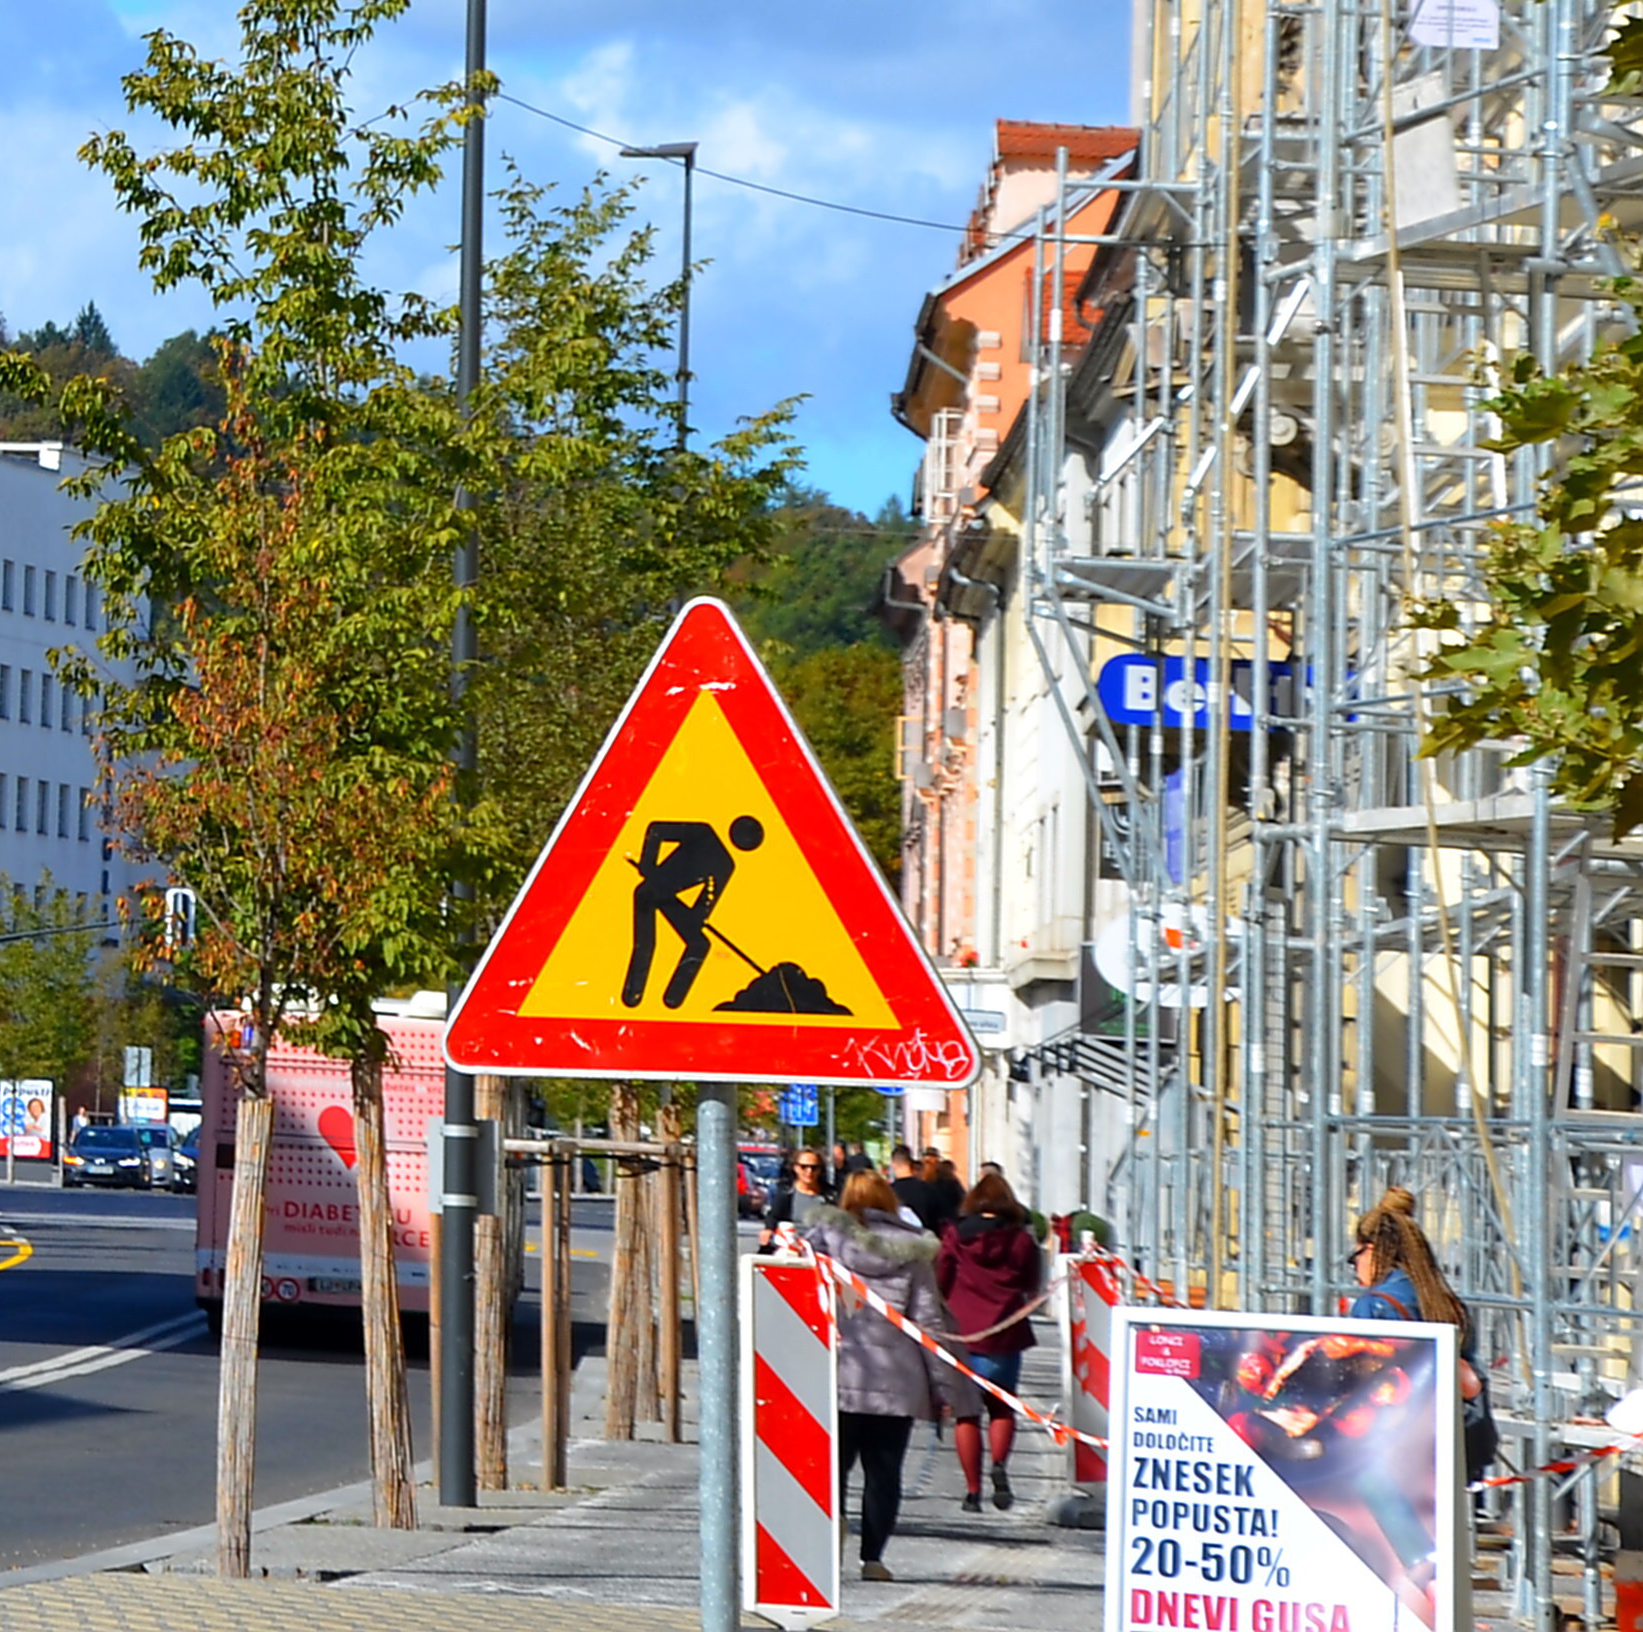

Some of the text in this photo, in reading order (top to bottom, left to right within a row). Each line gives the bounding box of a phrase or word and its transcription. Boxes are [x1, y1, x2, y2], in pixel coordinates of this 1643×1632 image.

[284, 1200, 412, 1226] DIABEU
[284, 1223, 315, 1236] misli
[319, 1224, 347, 1237] tudi
[1134, 1406, 1178, 1426] SAMI
[1133, 1431, 1215, 1454] DOLOČITE
[1132, 1457, 1256, 1498] ZNESEK
[1131, 1498, 1278, 1538] POPUSTA!
[1130, 1535, 1291, 1588] 20-50%
[1130, 1588, 1352, 1632] DNEVI GUSA
